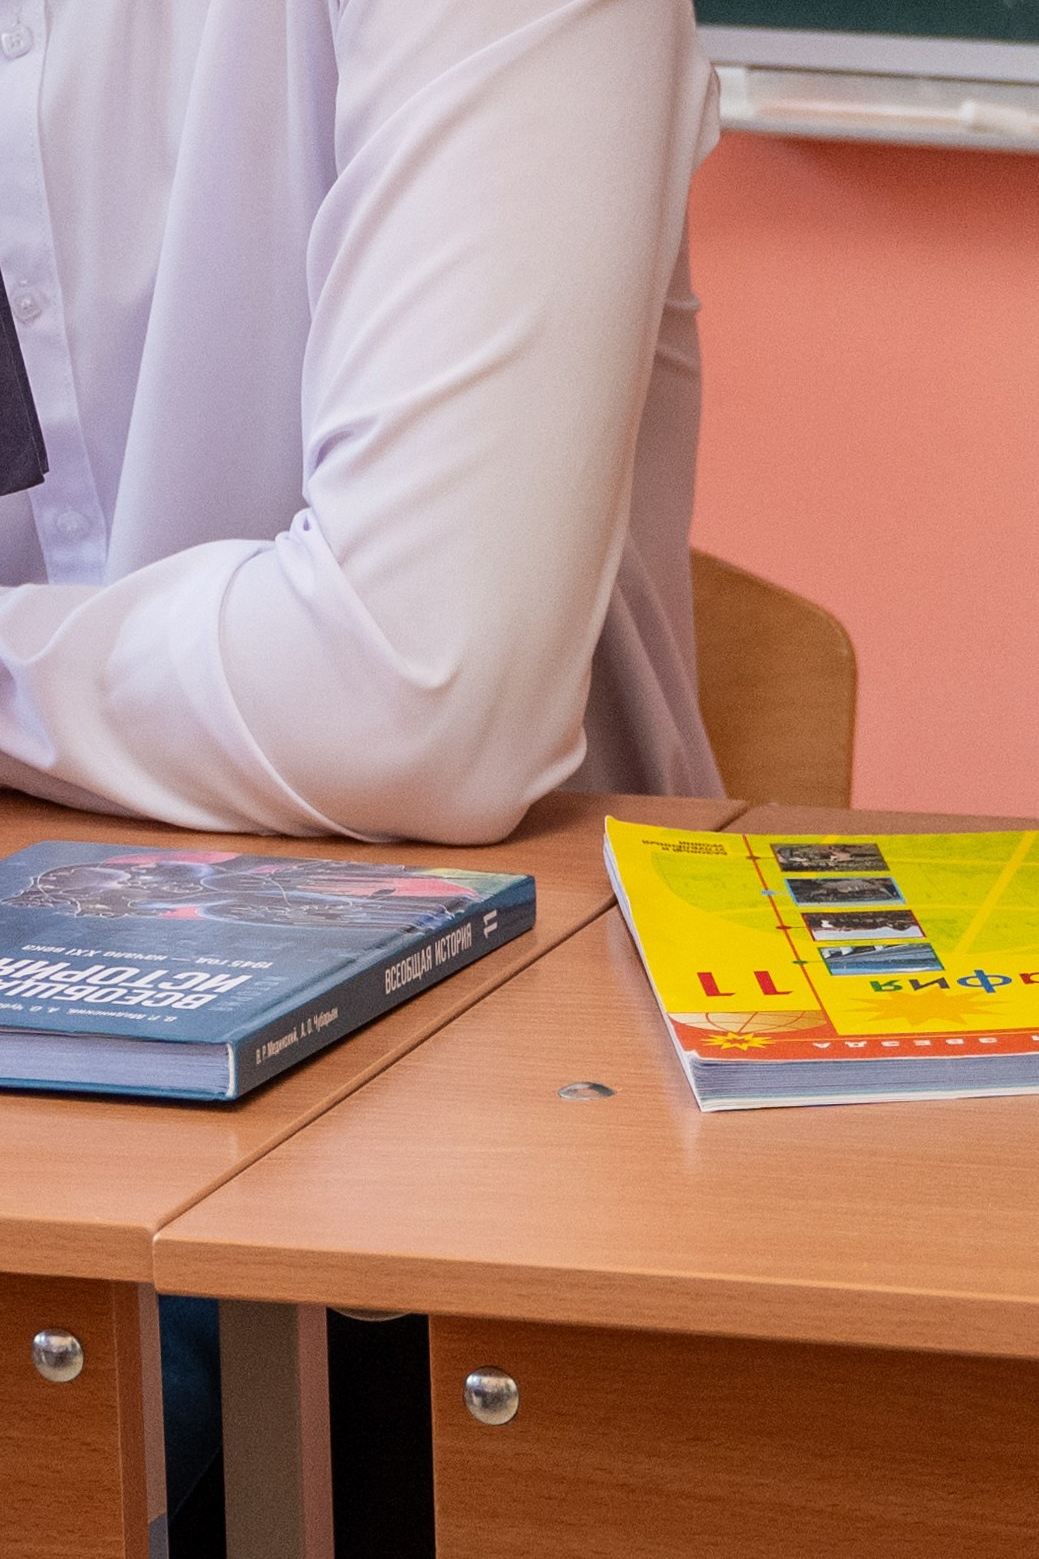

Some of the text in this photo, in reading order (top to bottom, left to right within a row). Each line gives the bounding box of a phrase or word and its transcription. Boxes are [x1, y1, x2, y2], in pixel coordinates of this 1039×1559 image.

[21, 944, 66, 954] века
[384, 948, 433, 995] ВСЕОБЩАЯ
[434, 922, 473, 965] ИСТОРИЯ
[482, 909, 499, 940] 11
[102, 950, 169, 962] начало
[194, 956, 226, 966] год
[226, 961, 274, 970] 1945
[696, 970, 794, 997] 11
